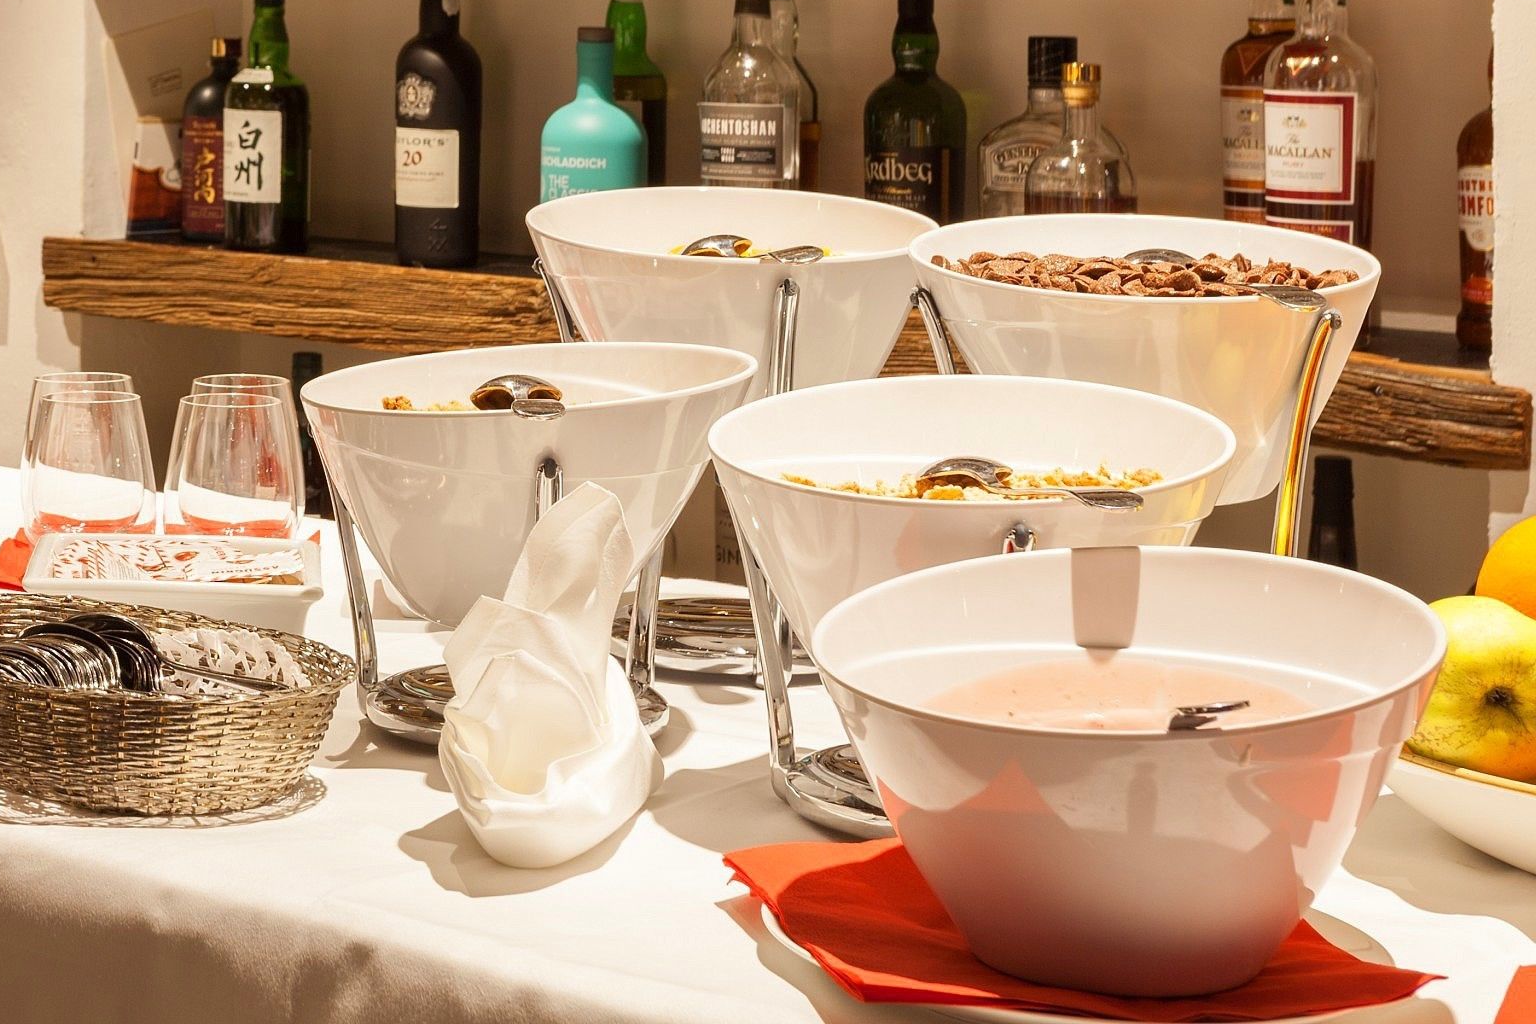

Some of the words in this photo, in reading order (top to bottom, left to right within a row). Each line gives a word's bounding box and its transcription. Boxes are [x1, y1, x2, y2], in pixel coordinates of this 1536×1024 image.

[1287, 134, 1301, 145] The
[234, 119, 264, 192] 白州
[402, 149, 423, 167] 20
[1267, 143, 1333, 159] MACALLAN
[548, 174, 570, 189] THE
[211, 564, 279, 575] ASSUGRIN
